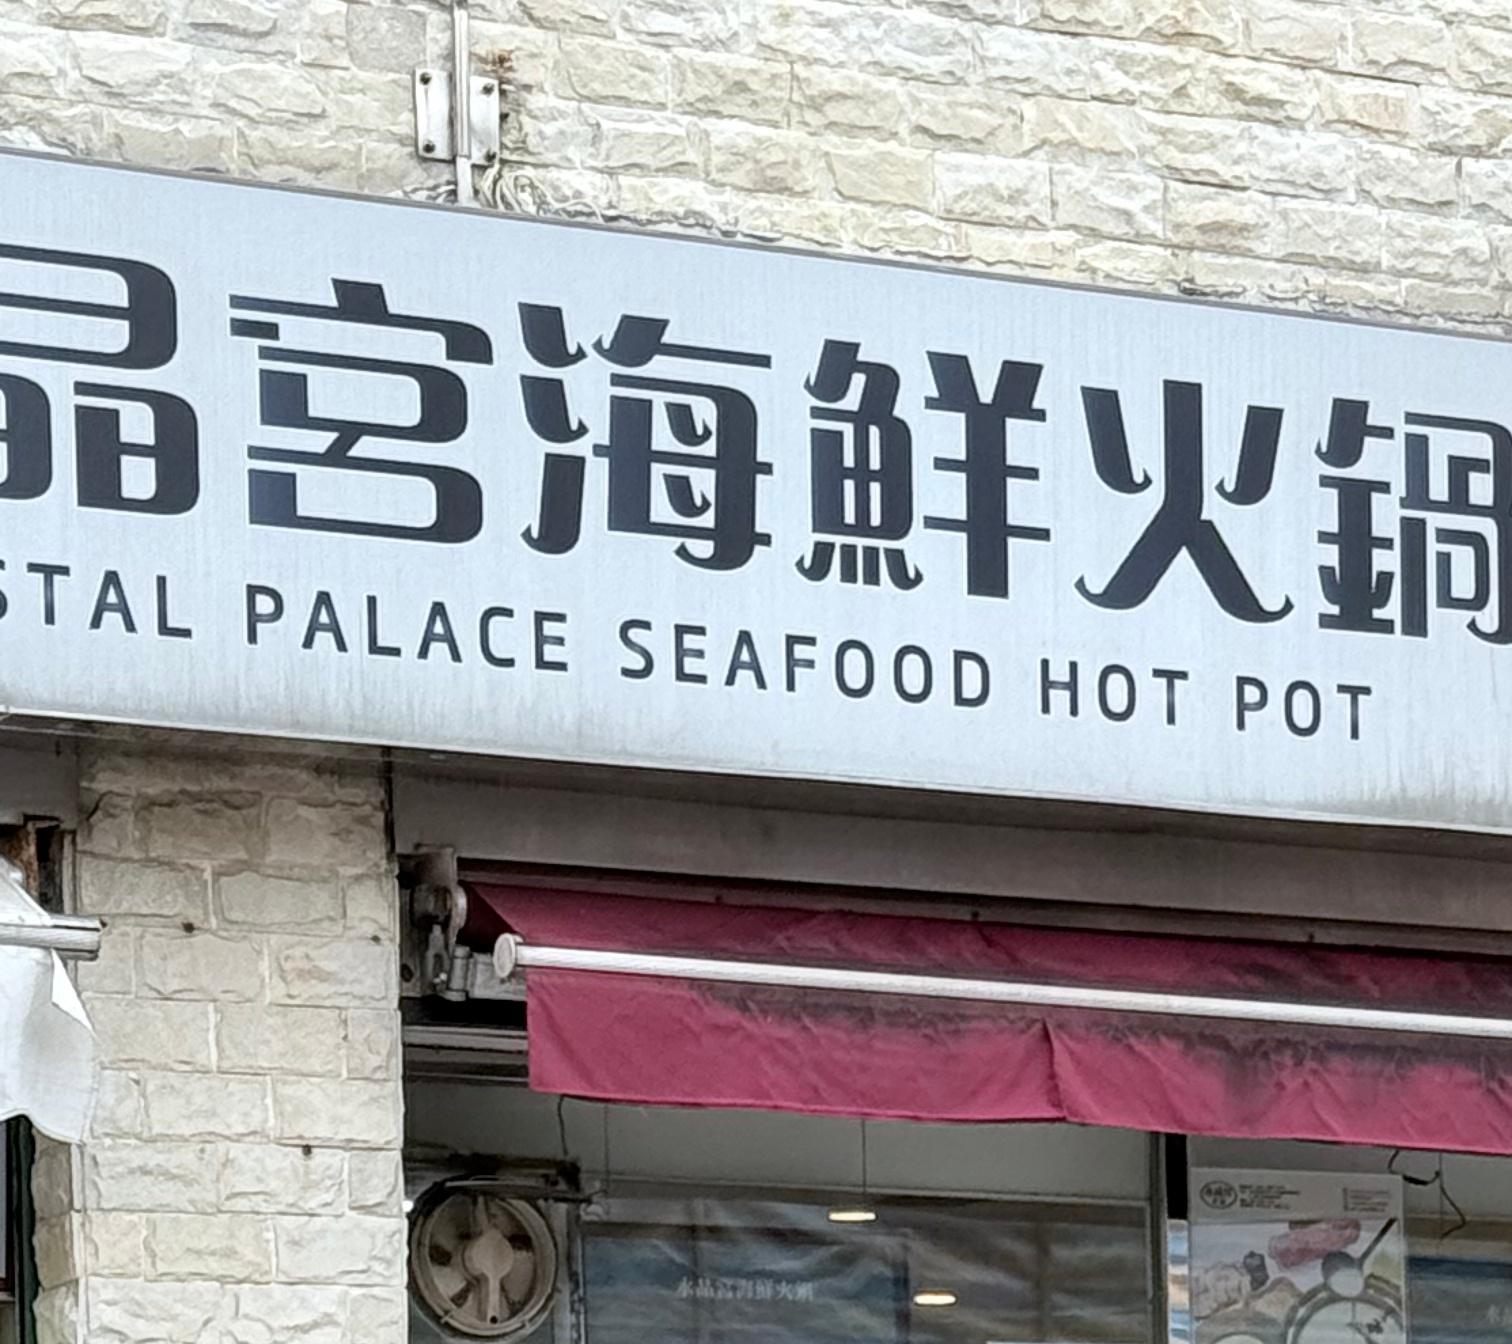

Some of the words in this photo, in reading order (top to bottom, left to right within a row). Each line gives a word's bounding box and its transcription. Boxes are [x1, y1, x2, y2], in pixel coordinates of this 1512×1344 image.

[0, 558, 192, 640] TAL
[245, 584, 569, 672] PALACE
[619, 618, 991, 708] SEAFOOD
[1040, 659, 1189, 726] HOT
[1236, 675, 1372, 741] POT
